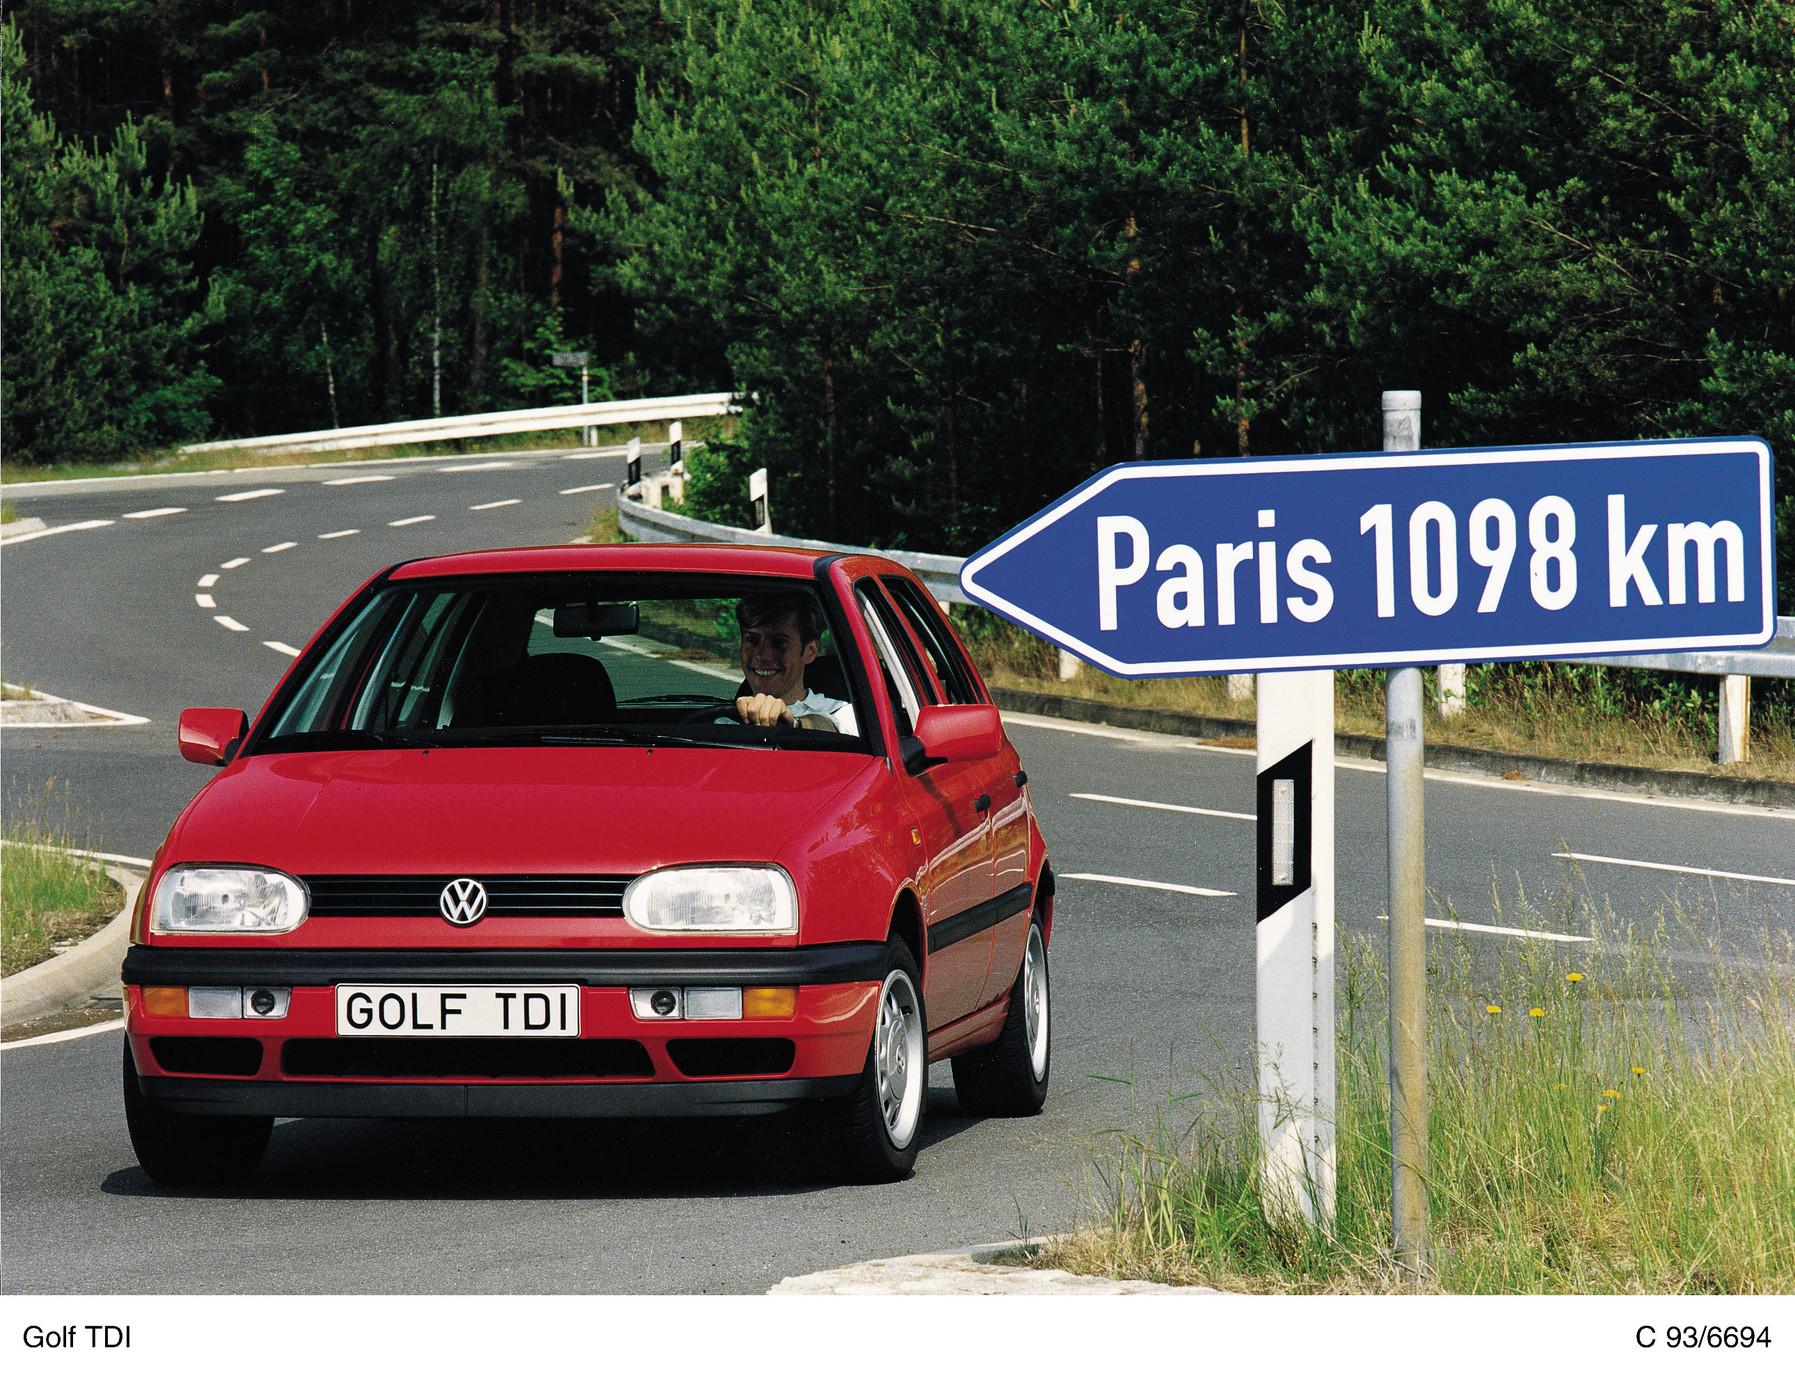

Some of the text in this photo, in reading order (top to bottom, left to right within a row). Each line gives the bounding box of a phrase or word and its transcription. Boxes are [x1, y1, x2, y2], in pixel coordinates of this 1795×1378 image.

[1096, 493, 1745, 631] Paris 1098 km
[440, 878, 487, 924] VW
[346, 992, 567, 1031] GOLF TDI
